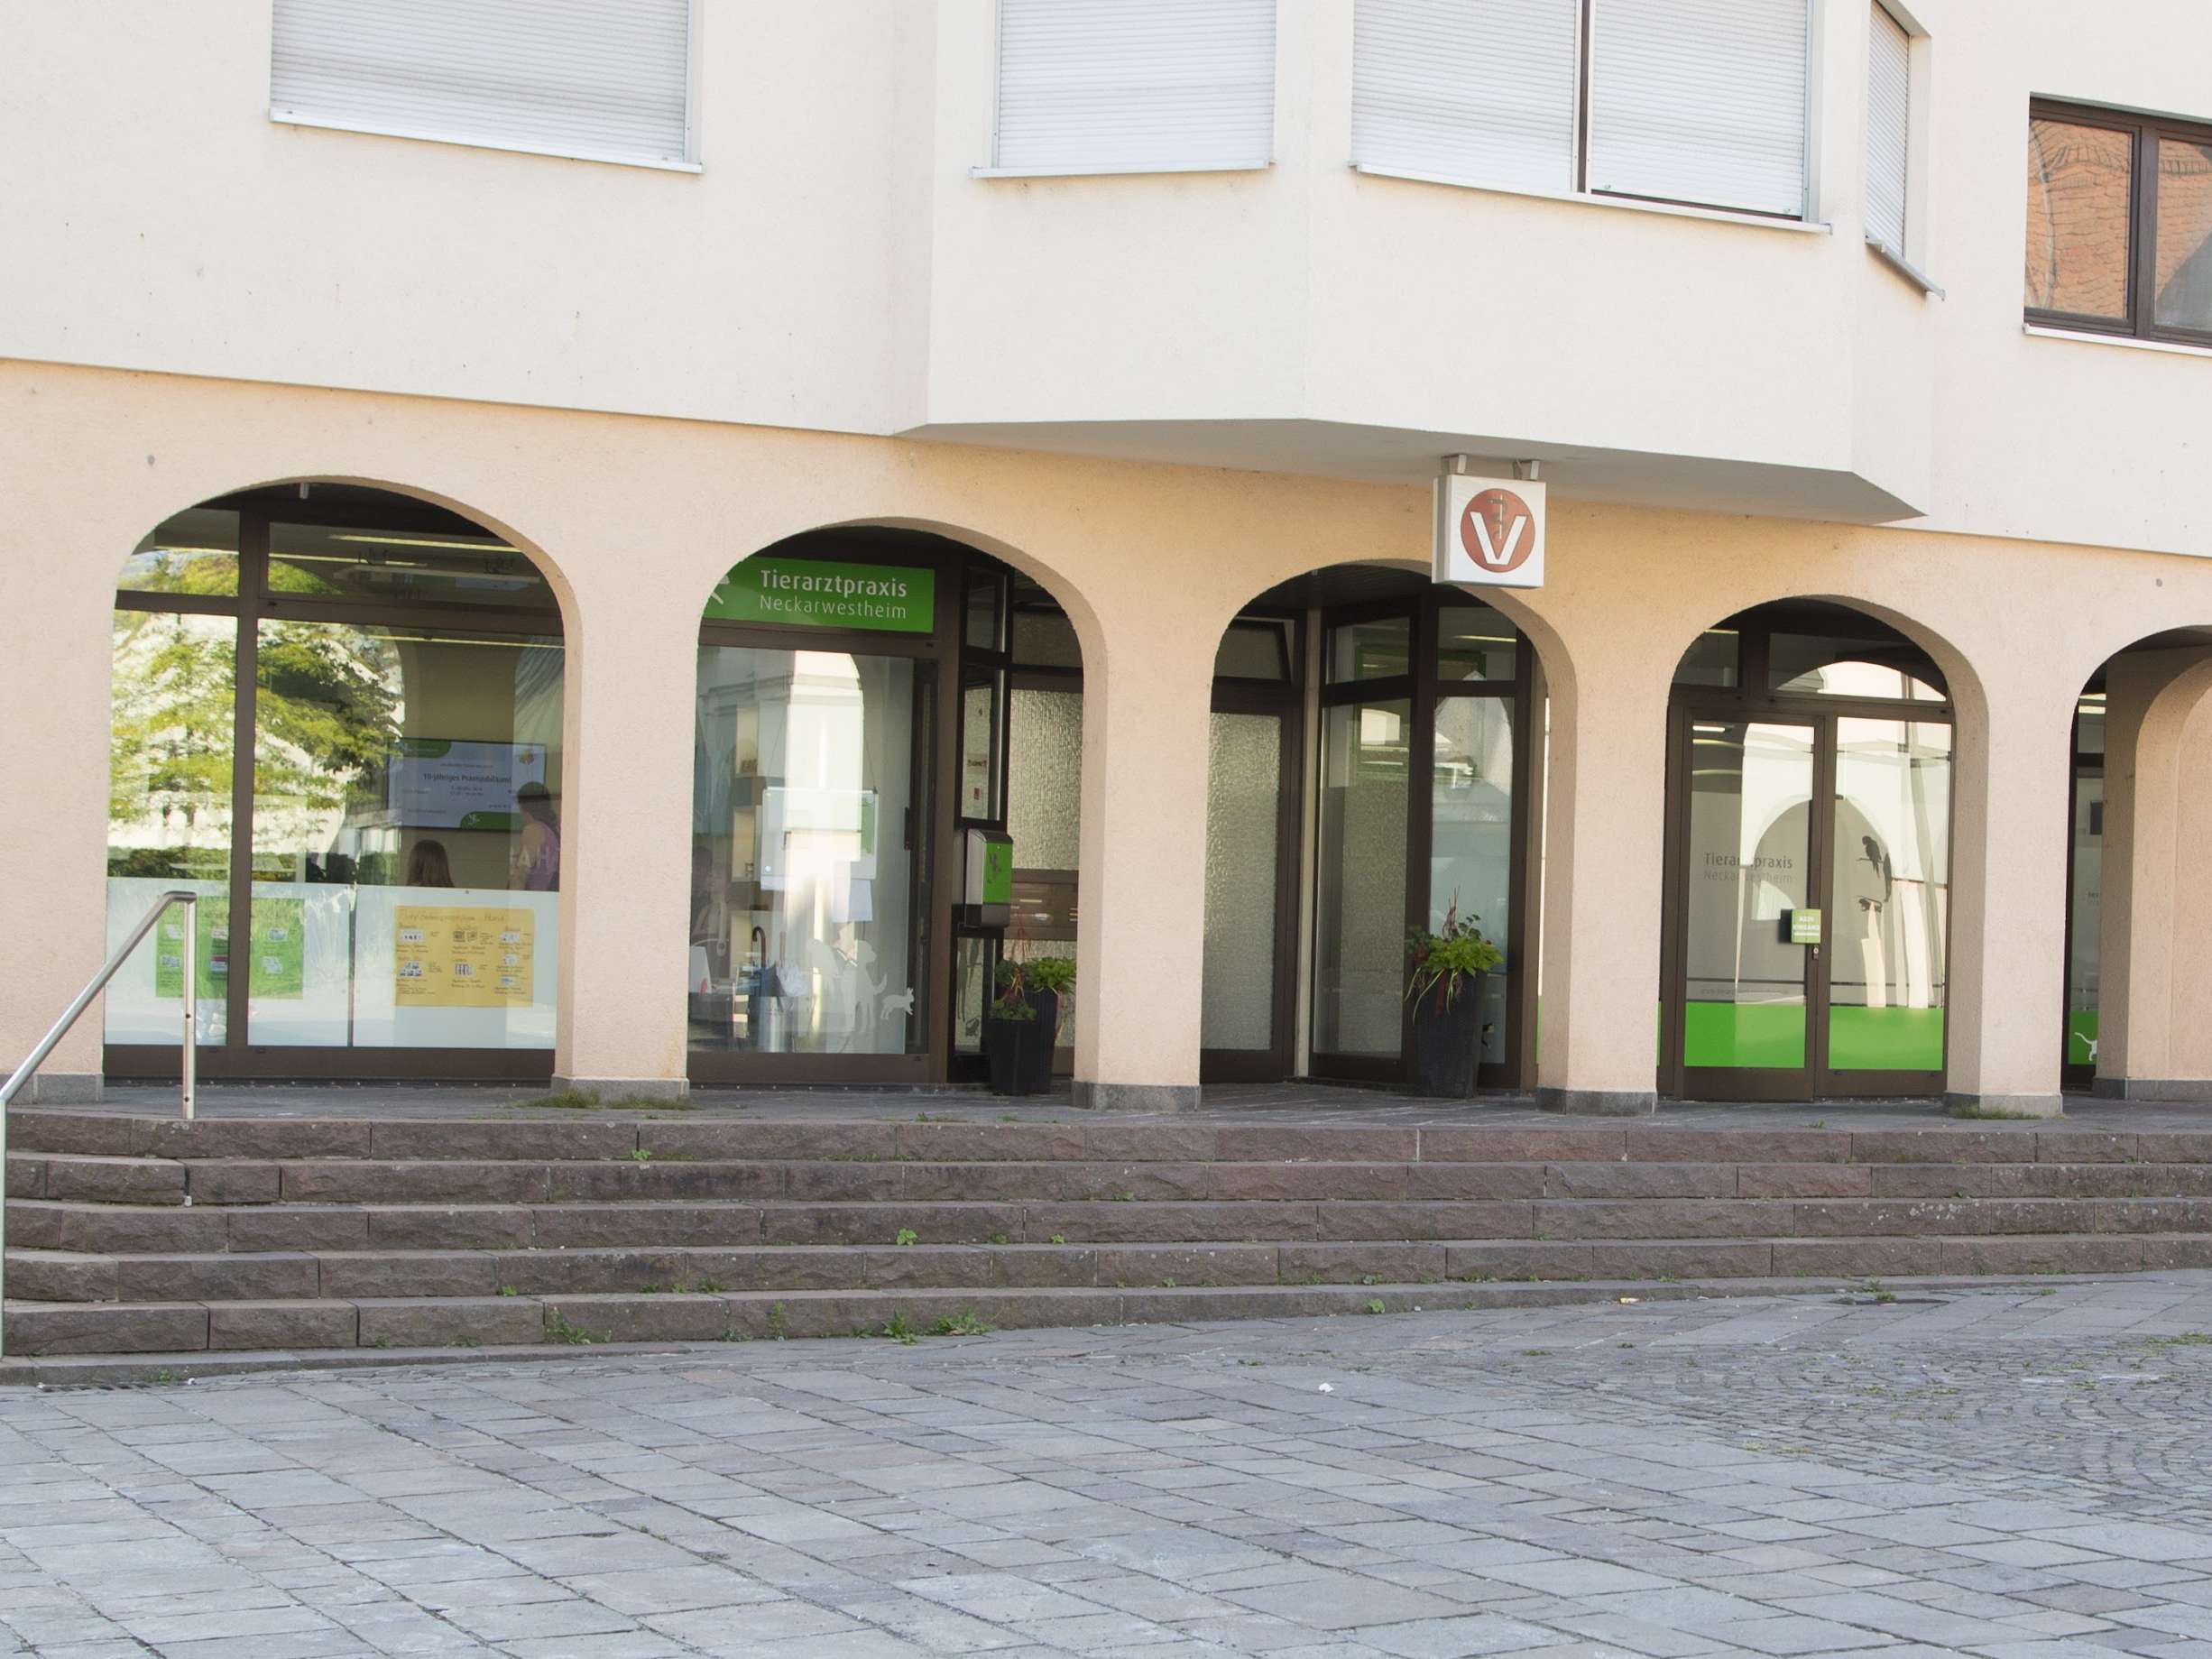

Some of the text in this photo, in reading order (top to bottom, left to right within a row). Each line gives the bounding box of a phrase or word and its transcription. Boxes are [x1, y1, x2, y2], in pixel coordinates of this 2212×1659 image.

[1470, 512, 1527, 566] V
[760, 569, 907, 598] Tierarztpraxis
[760, 595, 906, 619] Neckarwestheim
